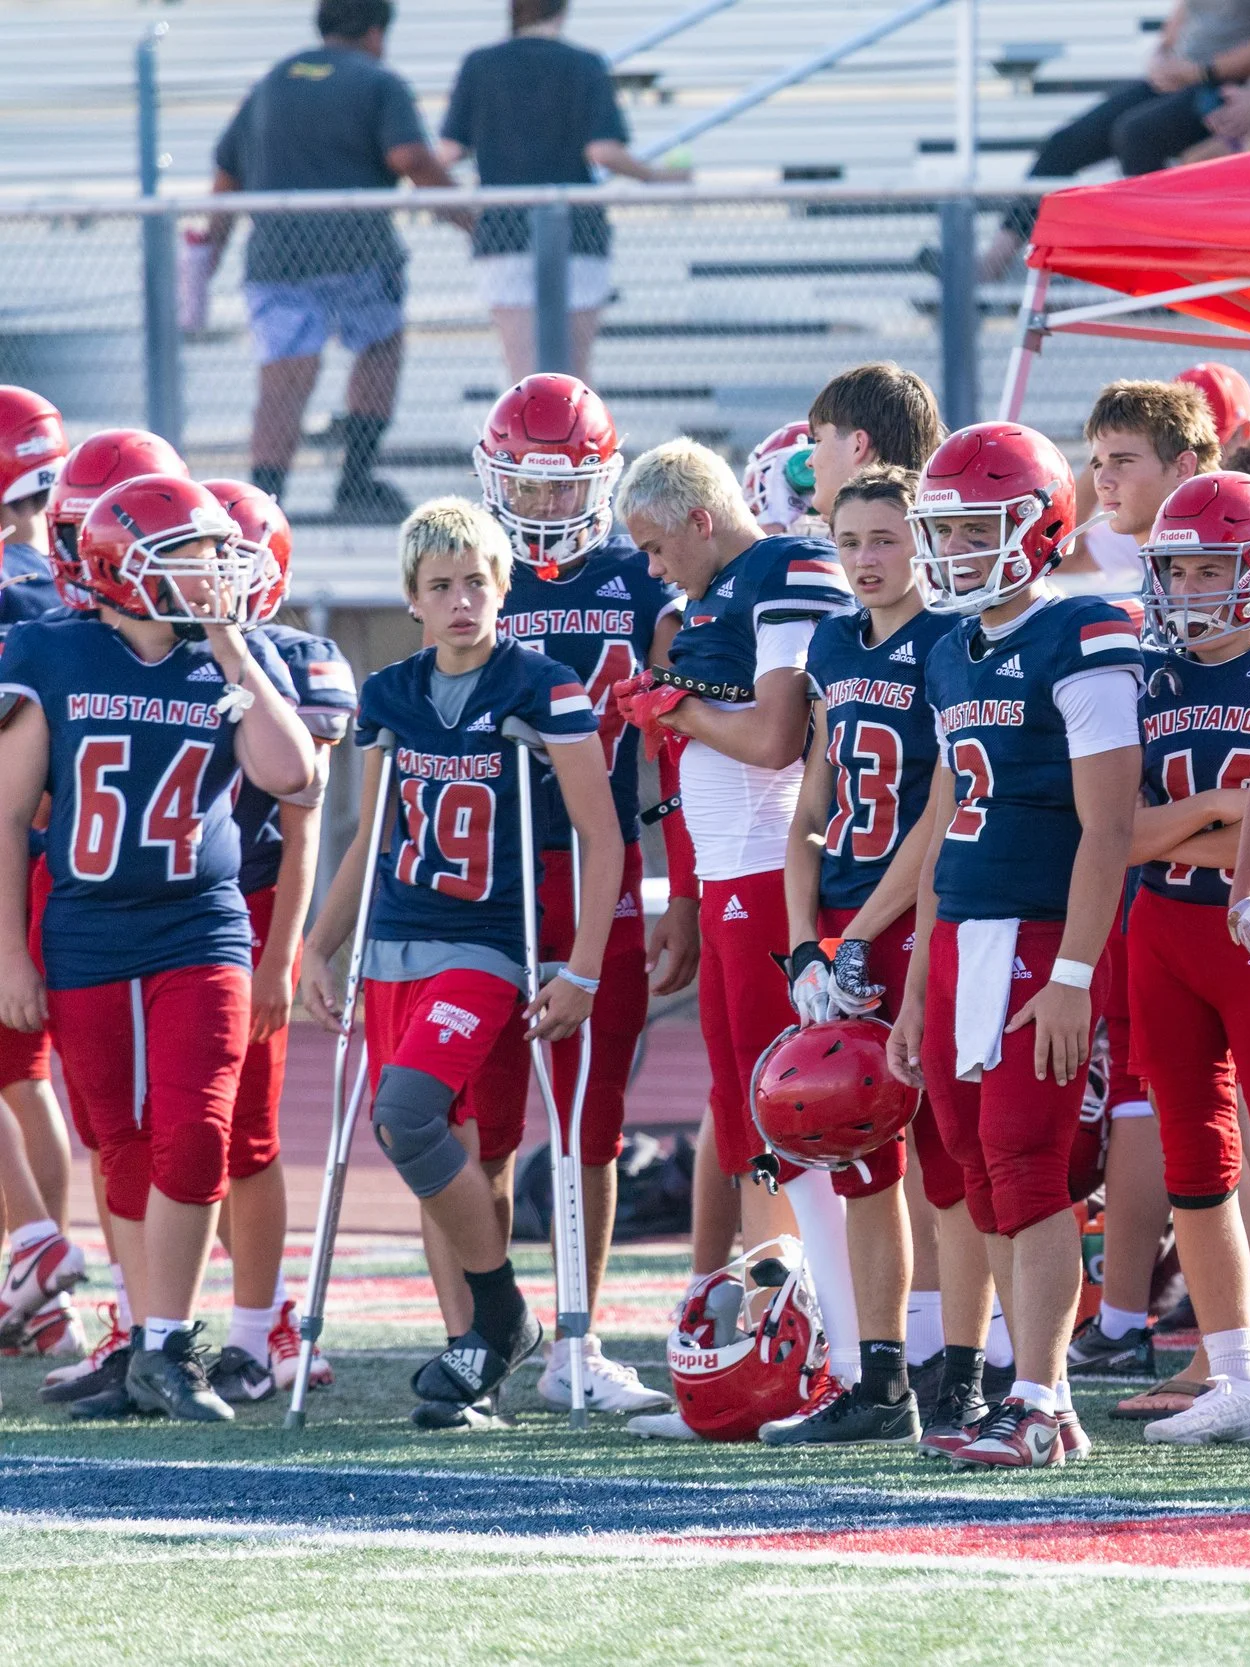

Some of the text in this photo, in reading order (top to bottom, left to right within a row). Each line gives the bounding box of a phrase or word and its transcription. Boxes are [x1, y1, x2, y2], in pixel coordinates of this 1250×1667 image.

[528, 457, 566, 466] Riddell
[923, 492, 953, 502] Riddell
[1160, 532, 1192, 541] Riddell
[596, 588, 632, 600] adidas
[889, 652, 917, 665] adidas
[186, 674, 224, 683] adidas
[996, 667, 1025, 679] adidas
[825, 677, 917, 711] MUSTANGS
[68, 692, 223, 730] MUSTANGS
[940, 699, 1026, 735] MUSTANGS
[825, 719, 904, 862] 13
[945, 737, 995, 843] 2
[69, 734, 216, 883] 64
[395, 778, 497, 902] 19
[722, 909, 749, 922] adidas
[425, 1013, 472, 1039] FOOTBALL
[433, 1000, 481, 1027] CRIMSON
[441, 1351, 483, 1391] adidas
